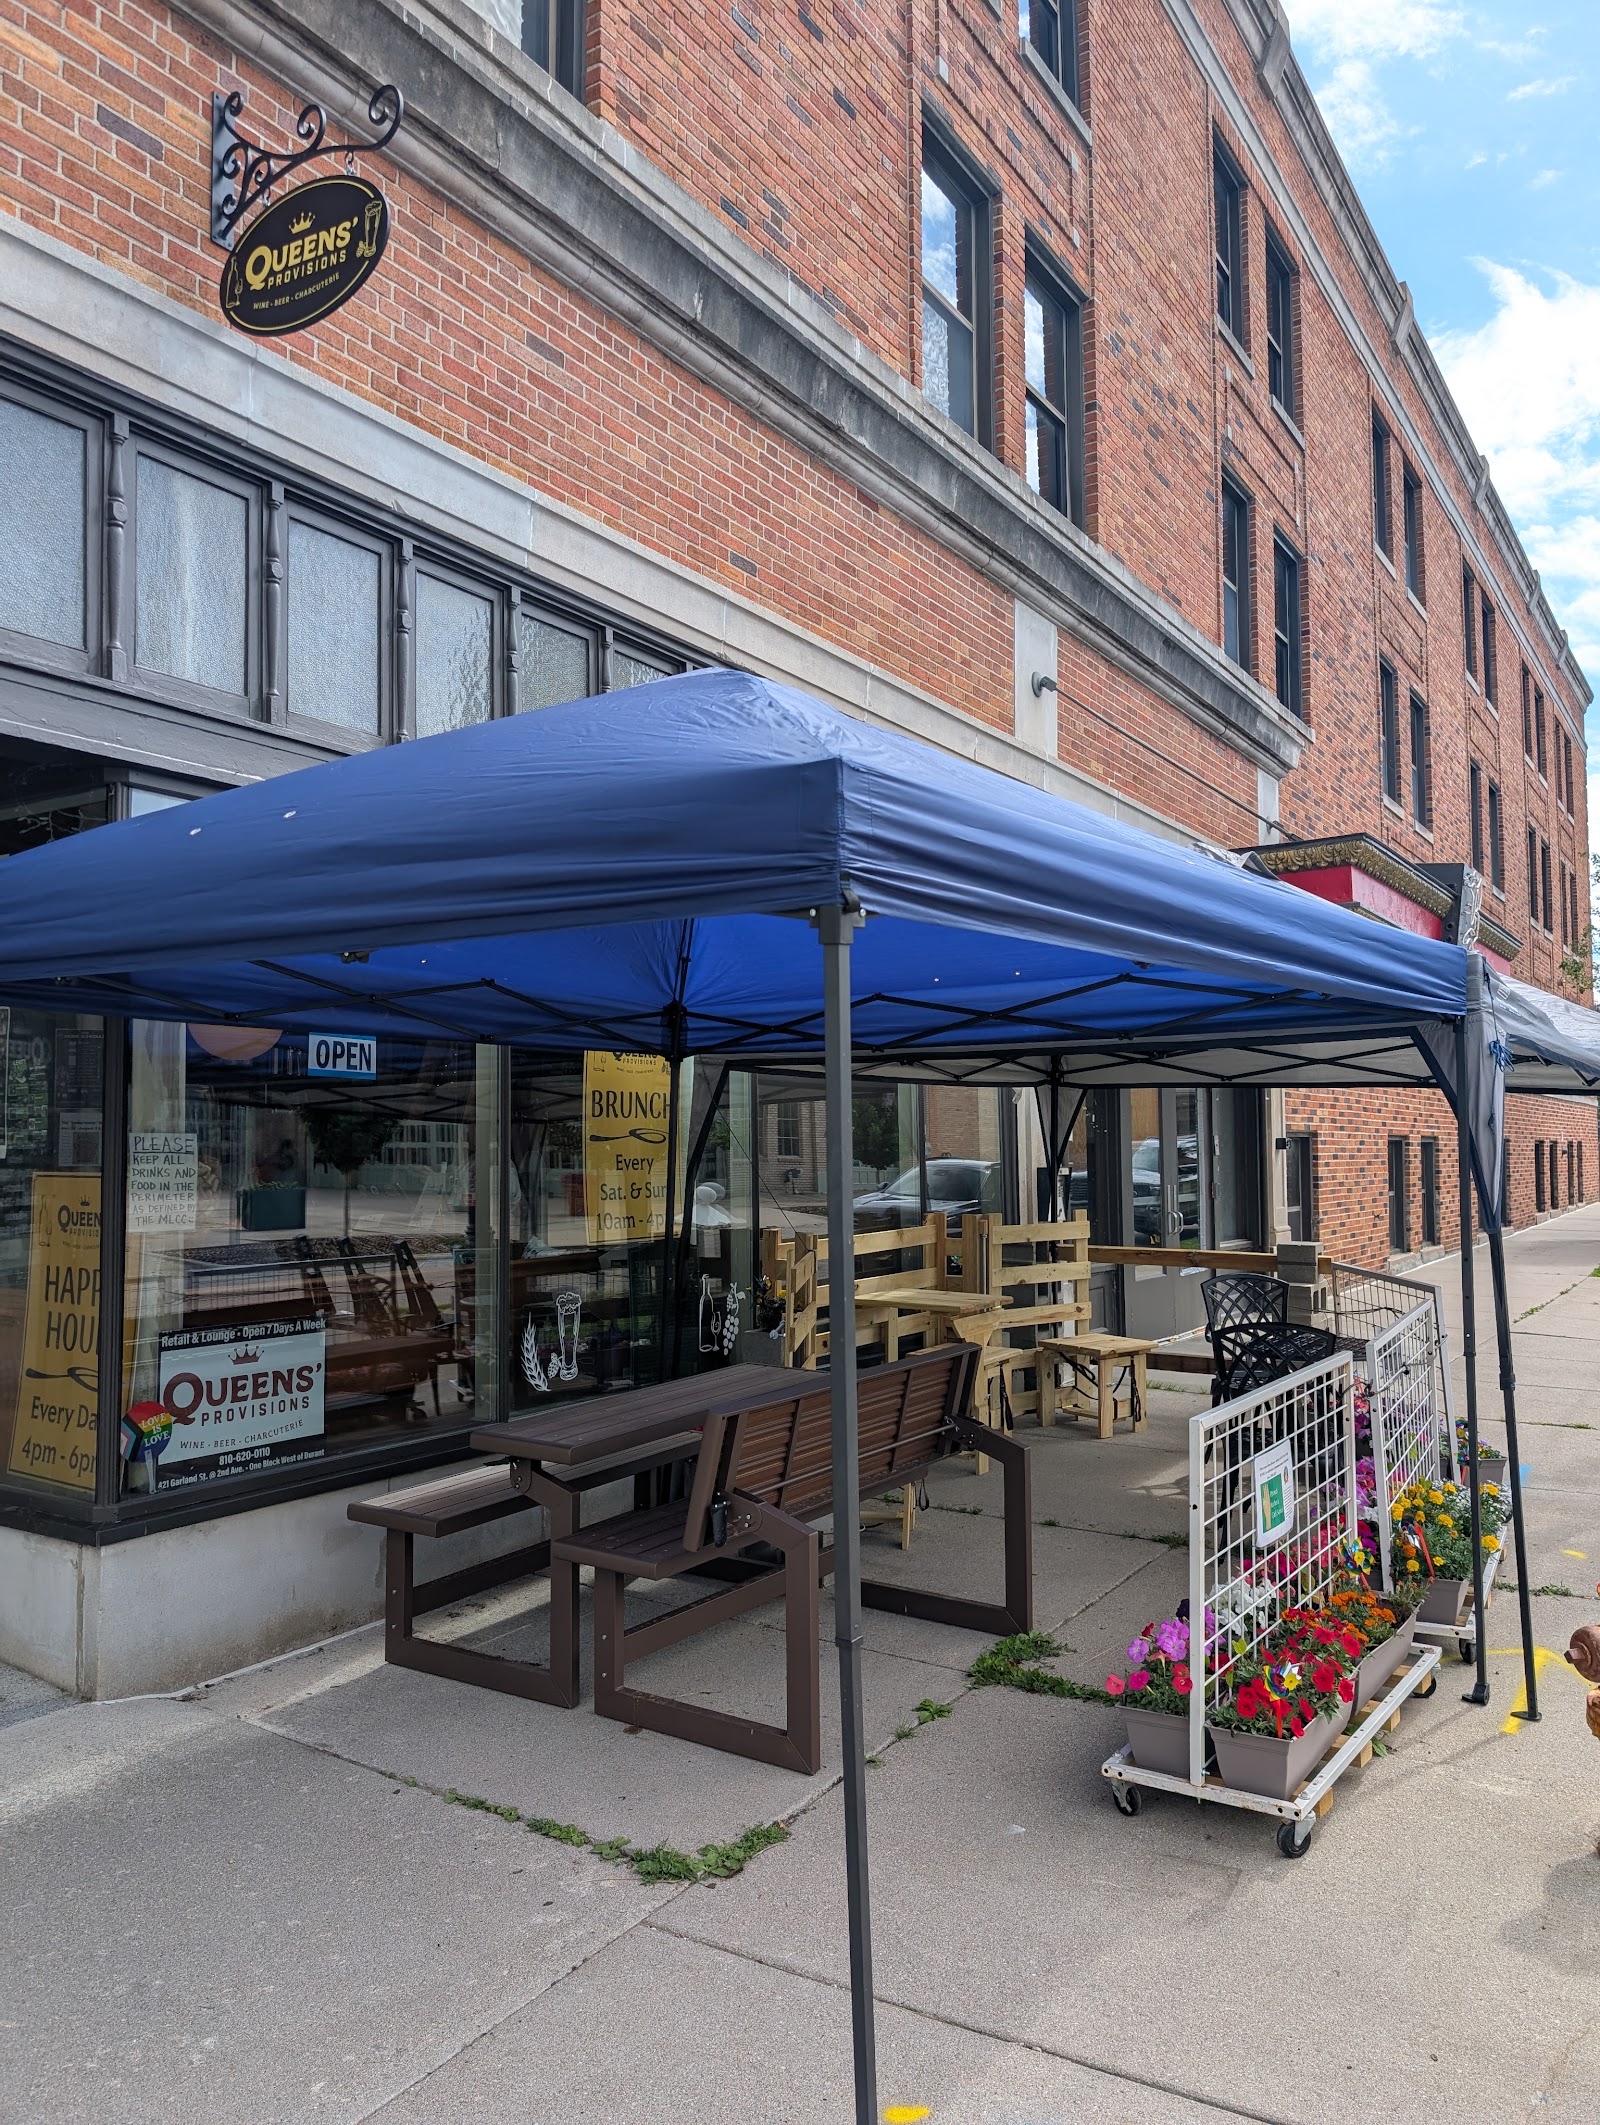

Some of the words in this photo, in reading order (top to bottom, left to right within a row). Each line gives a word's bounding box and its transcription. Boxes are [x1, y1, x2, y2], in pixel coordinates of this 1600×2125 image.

[245, 216, 359, 291] QUEENS'
[267, 249, 347, 290] PROVISIONS
[253, 300, 270, 310] WINE
[274, 296, 290, 307] BEER
[294, 272, 340, 300] CHARCUTERIE
[315, 1039, 372, 1072] OPEN
[622, 1058, 657, 1066] PROVISIONS
[591, 1089, 670, 1119] BRUNCH
[134, 1136, 194, 1153] PLEASE
[132, 1166, 171, 1178] DRINKS
[174, 1167, 196, 1179] AND
[133, 1154, 159, 1166] KEEP
[163, 1154, 185, 1166] ALL
[615, 1154, 654, 1175] Every
[131, 1180, 156, 1190] FOOD
[159, 1181, 170, 1191] IN
[174, 1182, 195, 1192] THE
[131, 1192, 195, 1202] PERIMETER
[600, 1182, 627, 1201] Sat.
[630, 1181, 642, 1200] &
[58, 1204, 101, 1233] QUEEN
[132, 1204, 144, 1215] AS
[148, 1203, 185, 1213] DEFINED
[187, 1203, 197, 1212] BY
[135, 1215, 154, 1227] THE
[596, 1212, 636, 1231] 10am
[646, 1211, 664, 1231] 4p
[45, 1264, 101, 1307] HAPP
[45, 1311, 99, 1354] HOU
[161, 1334, 190, 1348] Retail
[191, 1334, 200, 1344] &
[201, 1330, 236, 1343] Lounge
[242, 1325, 266, 1339] Open
[266, 1325, 272, 1335] 7
[273, 1321, 295, 1334] Days
[295, 1321, 302, 1331] A
[302, 1318, 326, 1331] Week
[163, 1362, 322, 1426] QUEENS'
[31, 1396, 75, 1432] Every
[77, 1404, 98, 1431] Da
[141, 1412, 167, 1428] LOVE
[201, 1396, 310, 1427] PROVISIONS
[144, 1431, 170, 1447] LOVE
[152, 1424, 162, 1434] IS
[180, 1440, 205, 1449] WINE
[213, 1439, 236, 1448] BEER
[244, 1419, 304, 1444] CHARCUTERIE
[22, 1434, 57, 1466] 4pm
[219, 1446, 271, 1466] 810-620-0110
[170, 1474, 198, 1487] Garland
[198, 1472, 208, 1482] St.
[209, 1470, 216, 1480] @
[217, 1467, 230, 1478] 2nd
[230, 1464, 245, 1476] Ave.
[249, 1462, 262, 1471] One
[262, 1457, 281, 1469] Block
[281, 1455, 297, 1466] West
[296, 1453, 304, 1461] of
[303, 1449, 325, 1461] Durant
